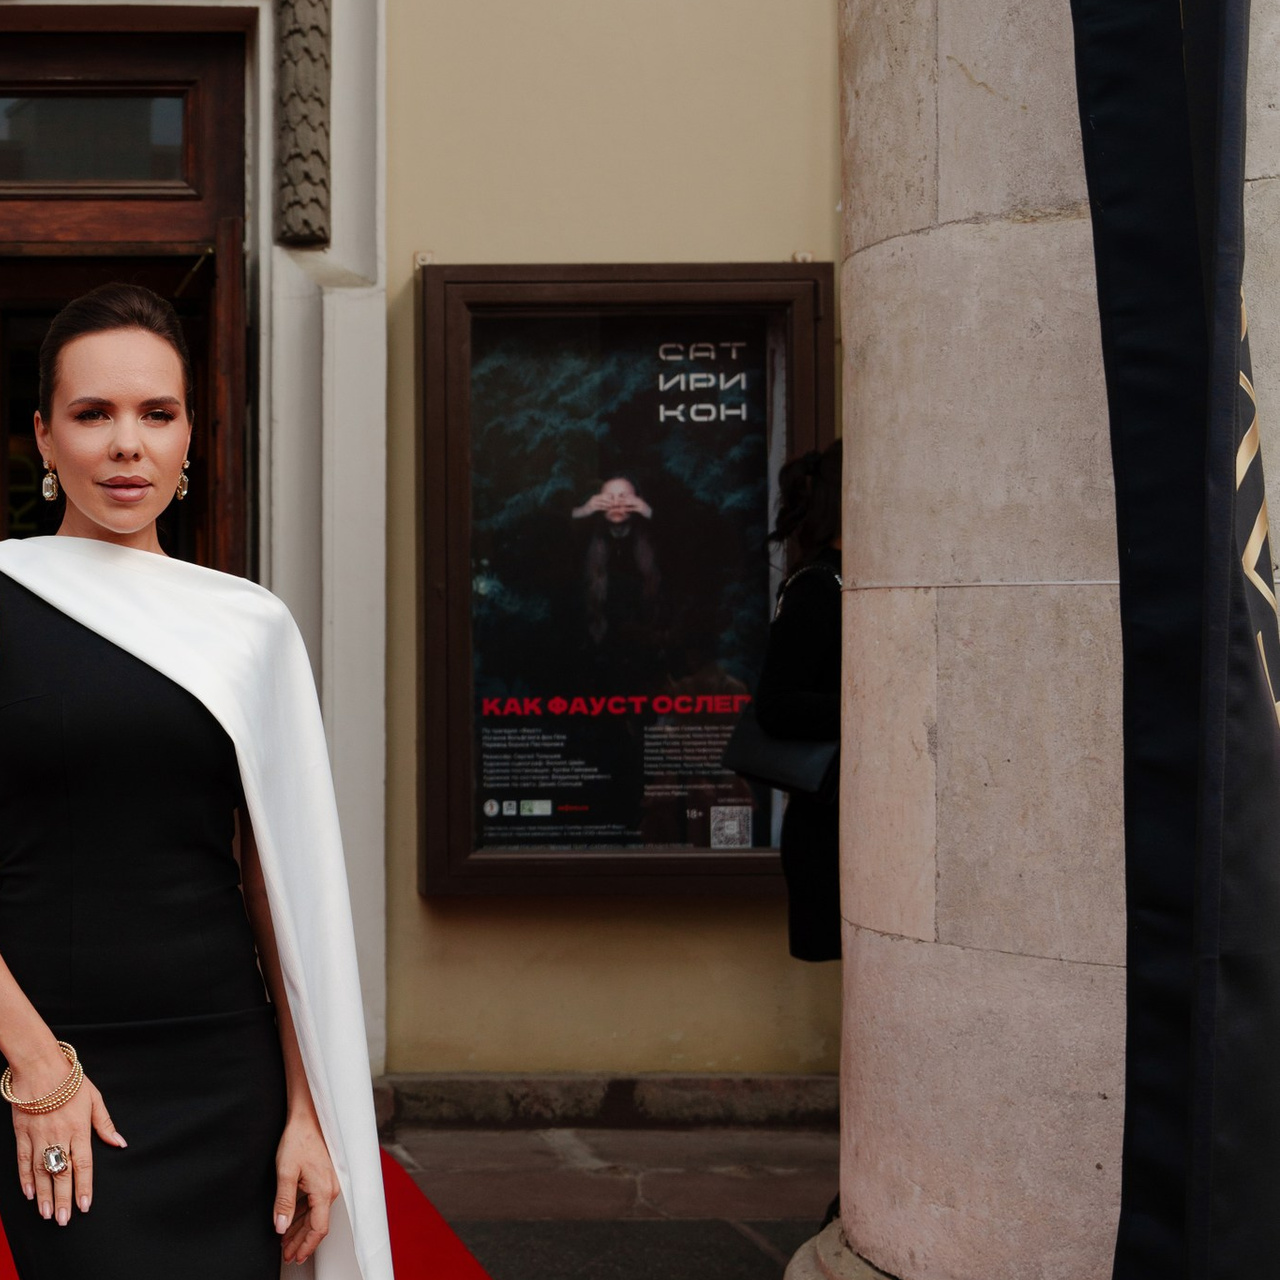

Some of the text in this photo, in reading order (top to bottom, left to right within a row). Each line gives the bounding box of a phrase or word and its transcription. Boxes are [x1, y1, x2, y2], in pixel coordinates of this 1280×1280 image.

[658, 341, 747, 361] САТ
[658, 372, 747, 392] ИРИ
[659, 403, 747, 423] КОН
[482, 697, 543, 716] КАК
[547, 695, 649, 716] ФАУСТ
